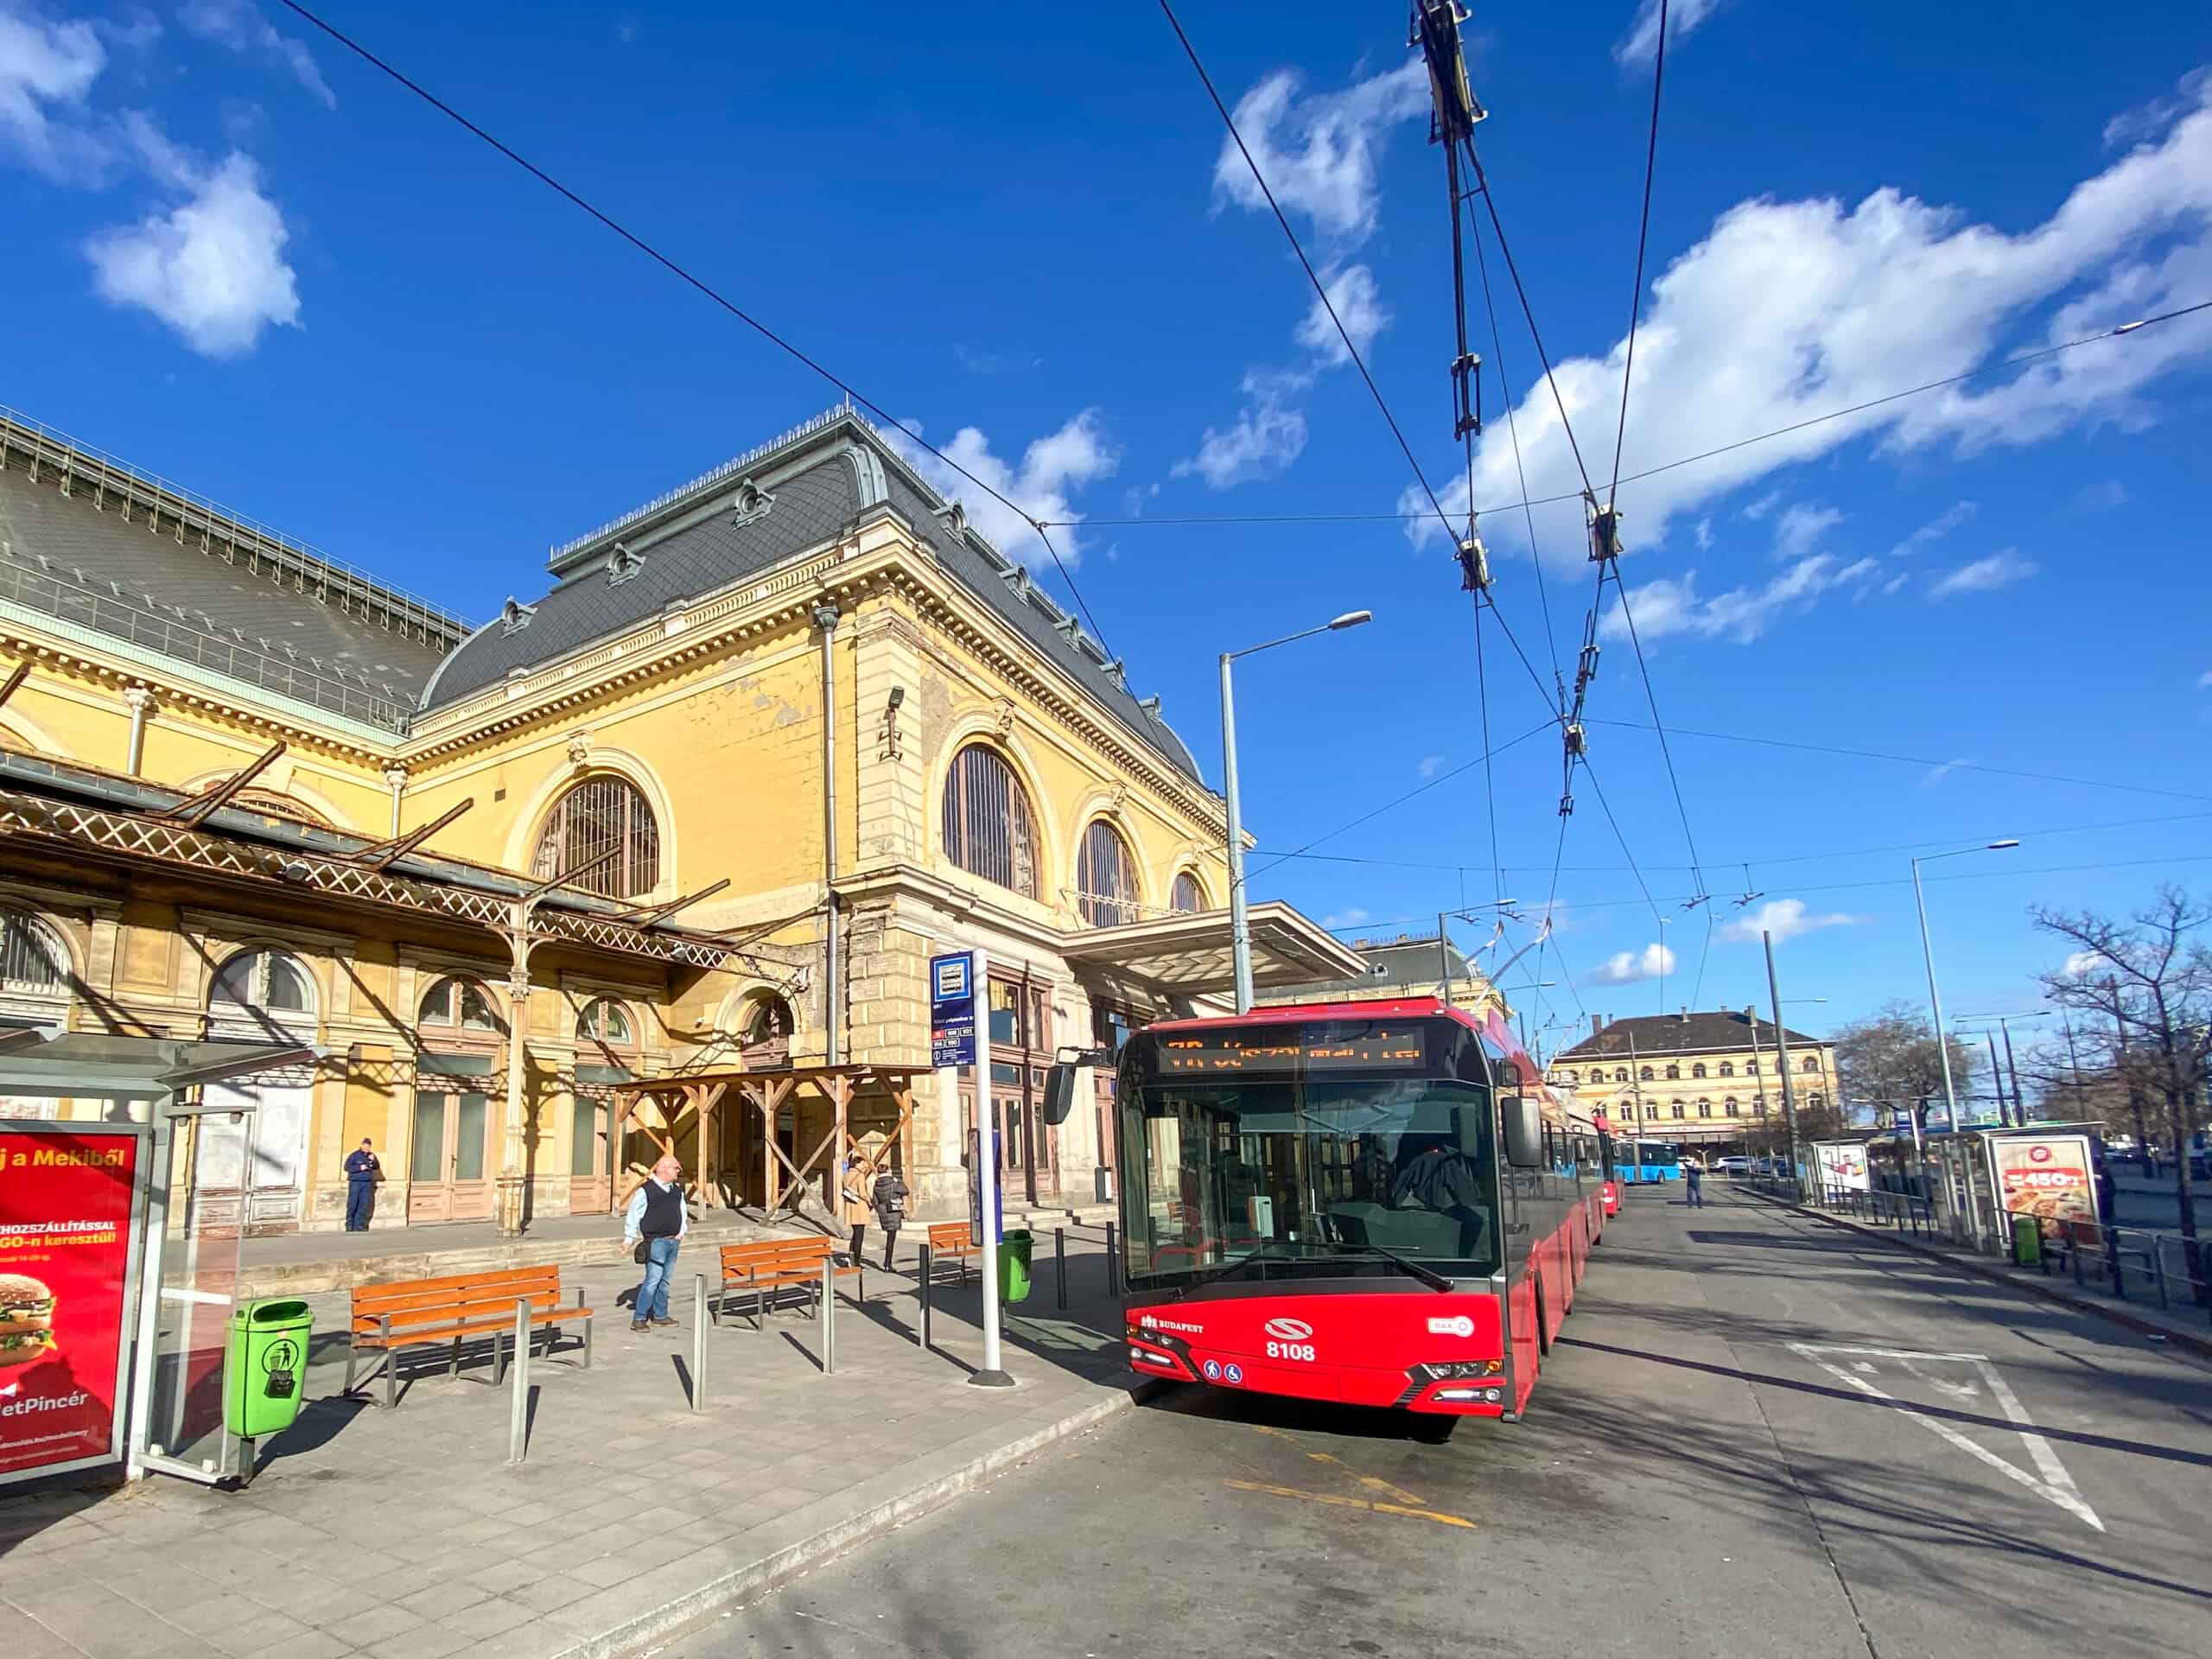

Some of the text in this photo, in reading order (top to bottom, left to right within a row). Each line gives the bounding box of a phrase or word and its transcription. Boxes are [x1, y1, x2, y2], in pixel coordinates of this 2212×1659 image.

[11, 1153, 27, 1166] a
[32, 1148, 125, 1166] Mekiből
[0, 1219, 116, 1236] HOZSZÁLLÍTÁSSAL
[1159, 1319, 1204, 1333] BUDAPEST
[1267, 1341, 1315, 1362] 8108
[0, 1389, 88, 1417] etPincér
